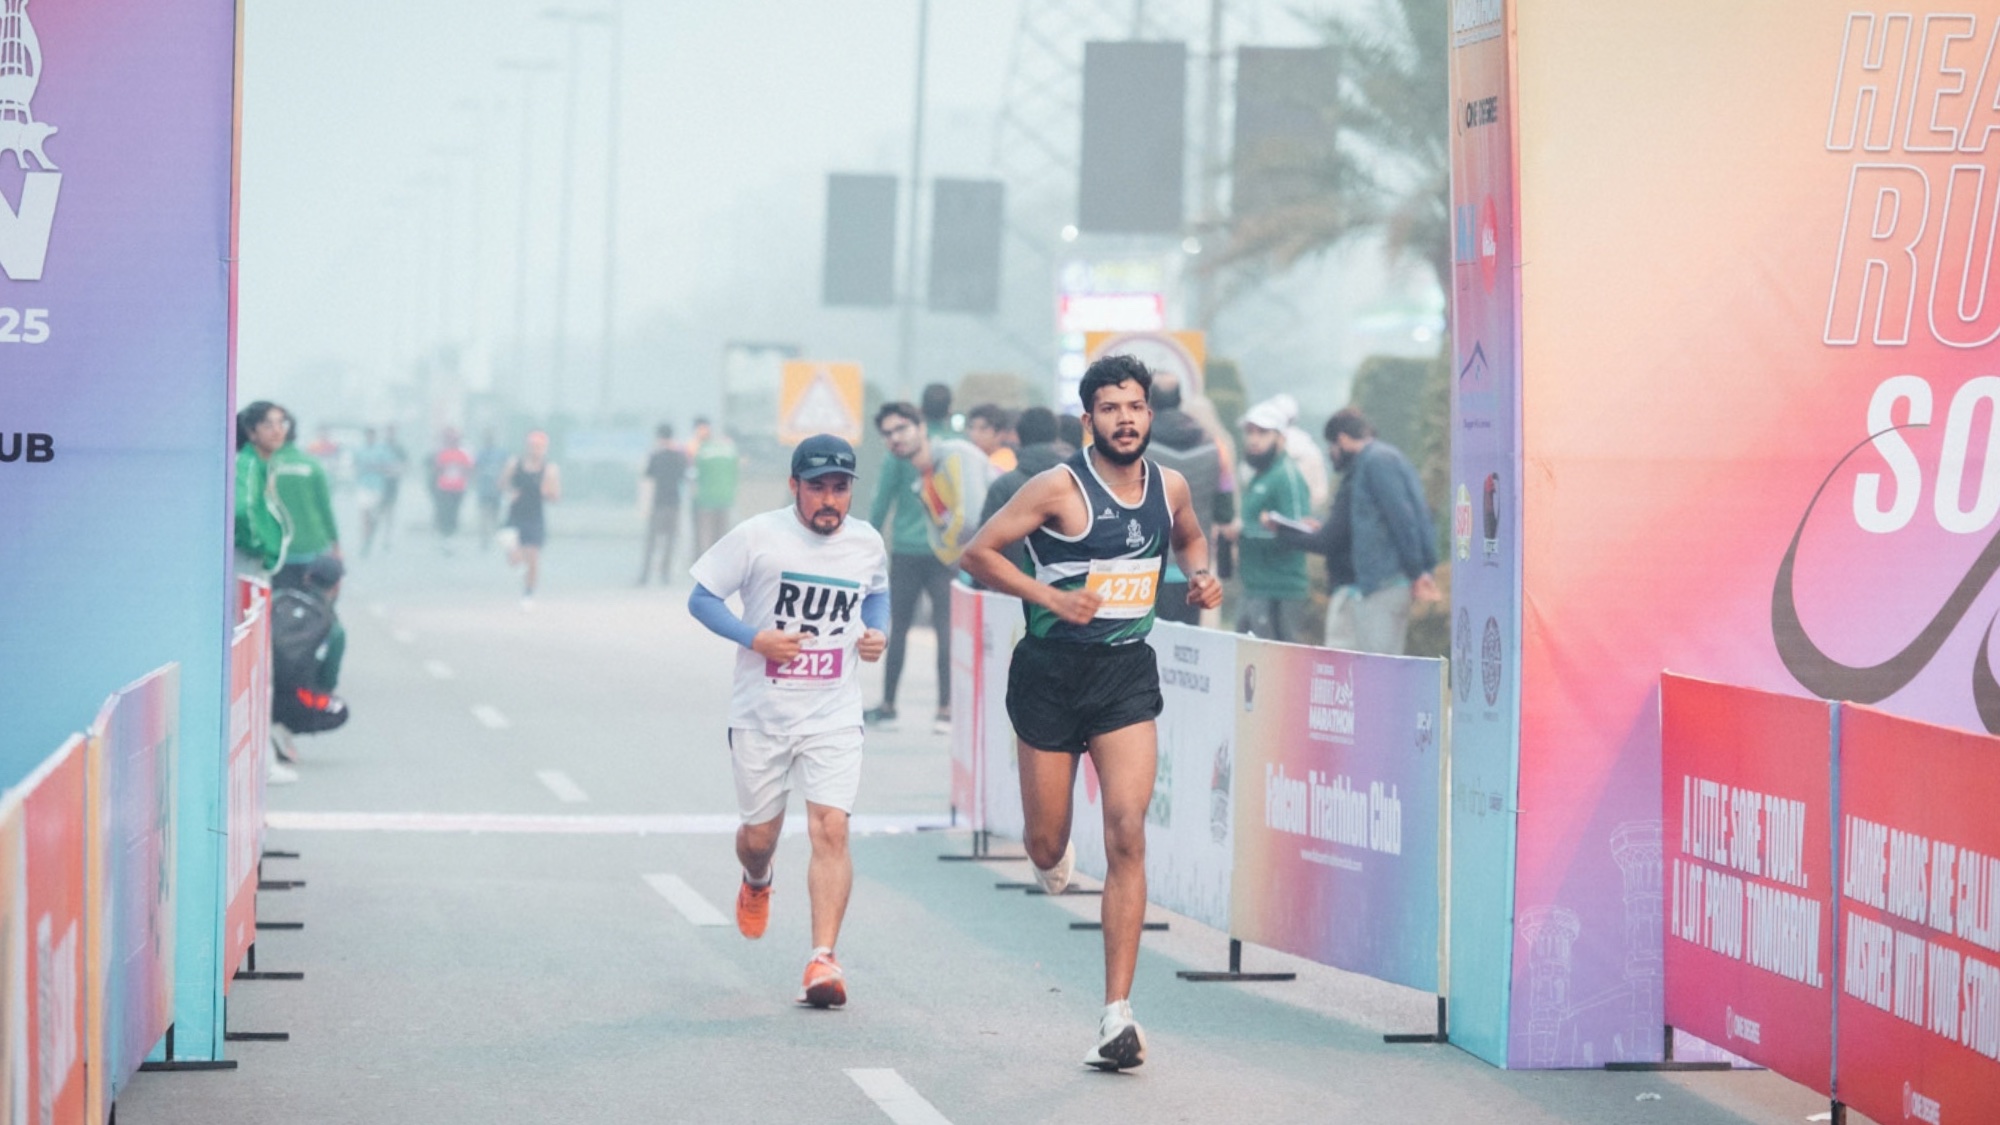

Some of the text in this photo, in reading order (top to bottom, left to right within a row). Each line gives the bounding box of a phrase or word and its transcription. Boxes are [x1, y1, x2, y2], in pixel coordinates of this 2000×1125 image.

[1823, 163, 2000, 349] RU
[0, 308, 50, 344] 25
[0, 432, 55, 463] UB
[1852, 374, 2000, 534] SO
[774, 582, 859, 622] RUN
[1097, 576, 1152, 602] 4278
[1265, 763, 1307, 836] Falcon
[1309, 770, 1367, 849] Triathlon
[1371, 781, 1402, 856] Club
[1681, 775, 1808, 889] A LITTLE SORE TODAY.
[1671, 858, 1824, 989] A LOT PROUD TOMORROW.
[1843, 814, 1888, 910] LAHORE
[1888, 828, 1928, 925] ROADS
[1929, 840, 1956, 934] ARE
[1844, 911, 2000, 1064] ANSWER WITH YOUR STRID
